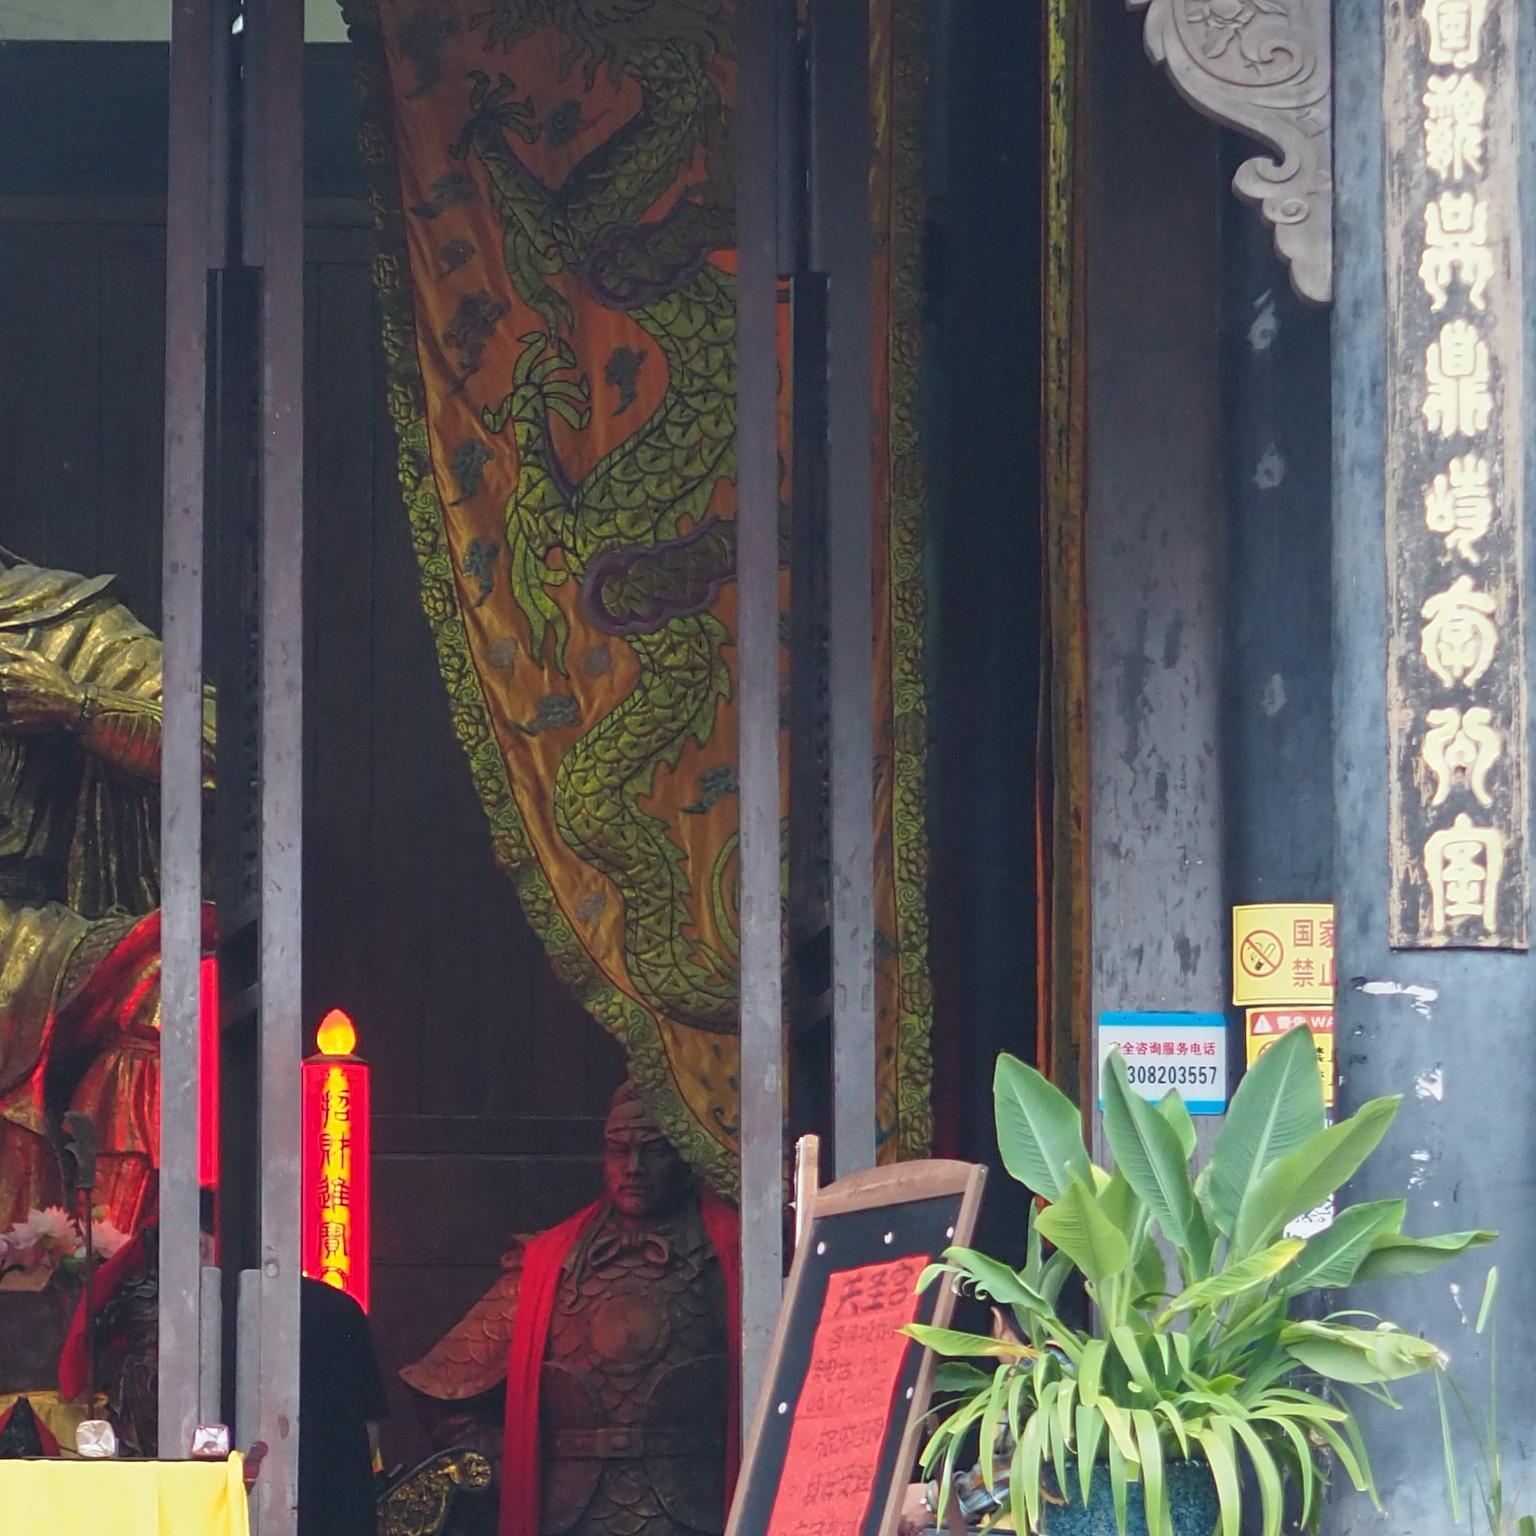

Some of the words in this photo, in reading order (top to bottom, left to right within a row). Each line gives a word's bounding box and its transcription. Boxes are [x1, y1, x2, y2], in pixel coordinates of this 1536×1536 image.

[1110, 1041, 1215, 1056] 全咨询服务电话
[1127, 1065, 1217, 1084] 308203557
